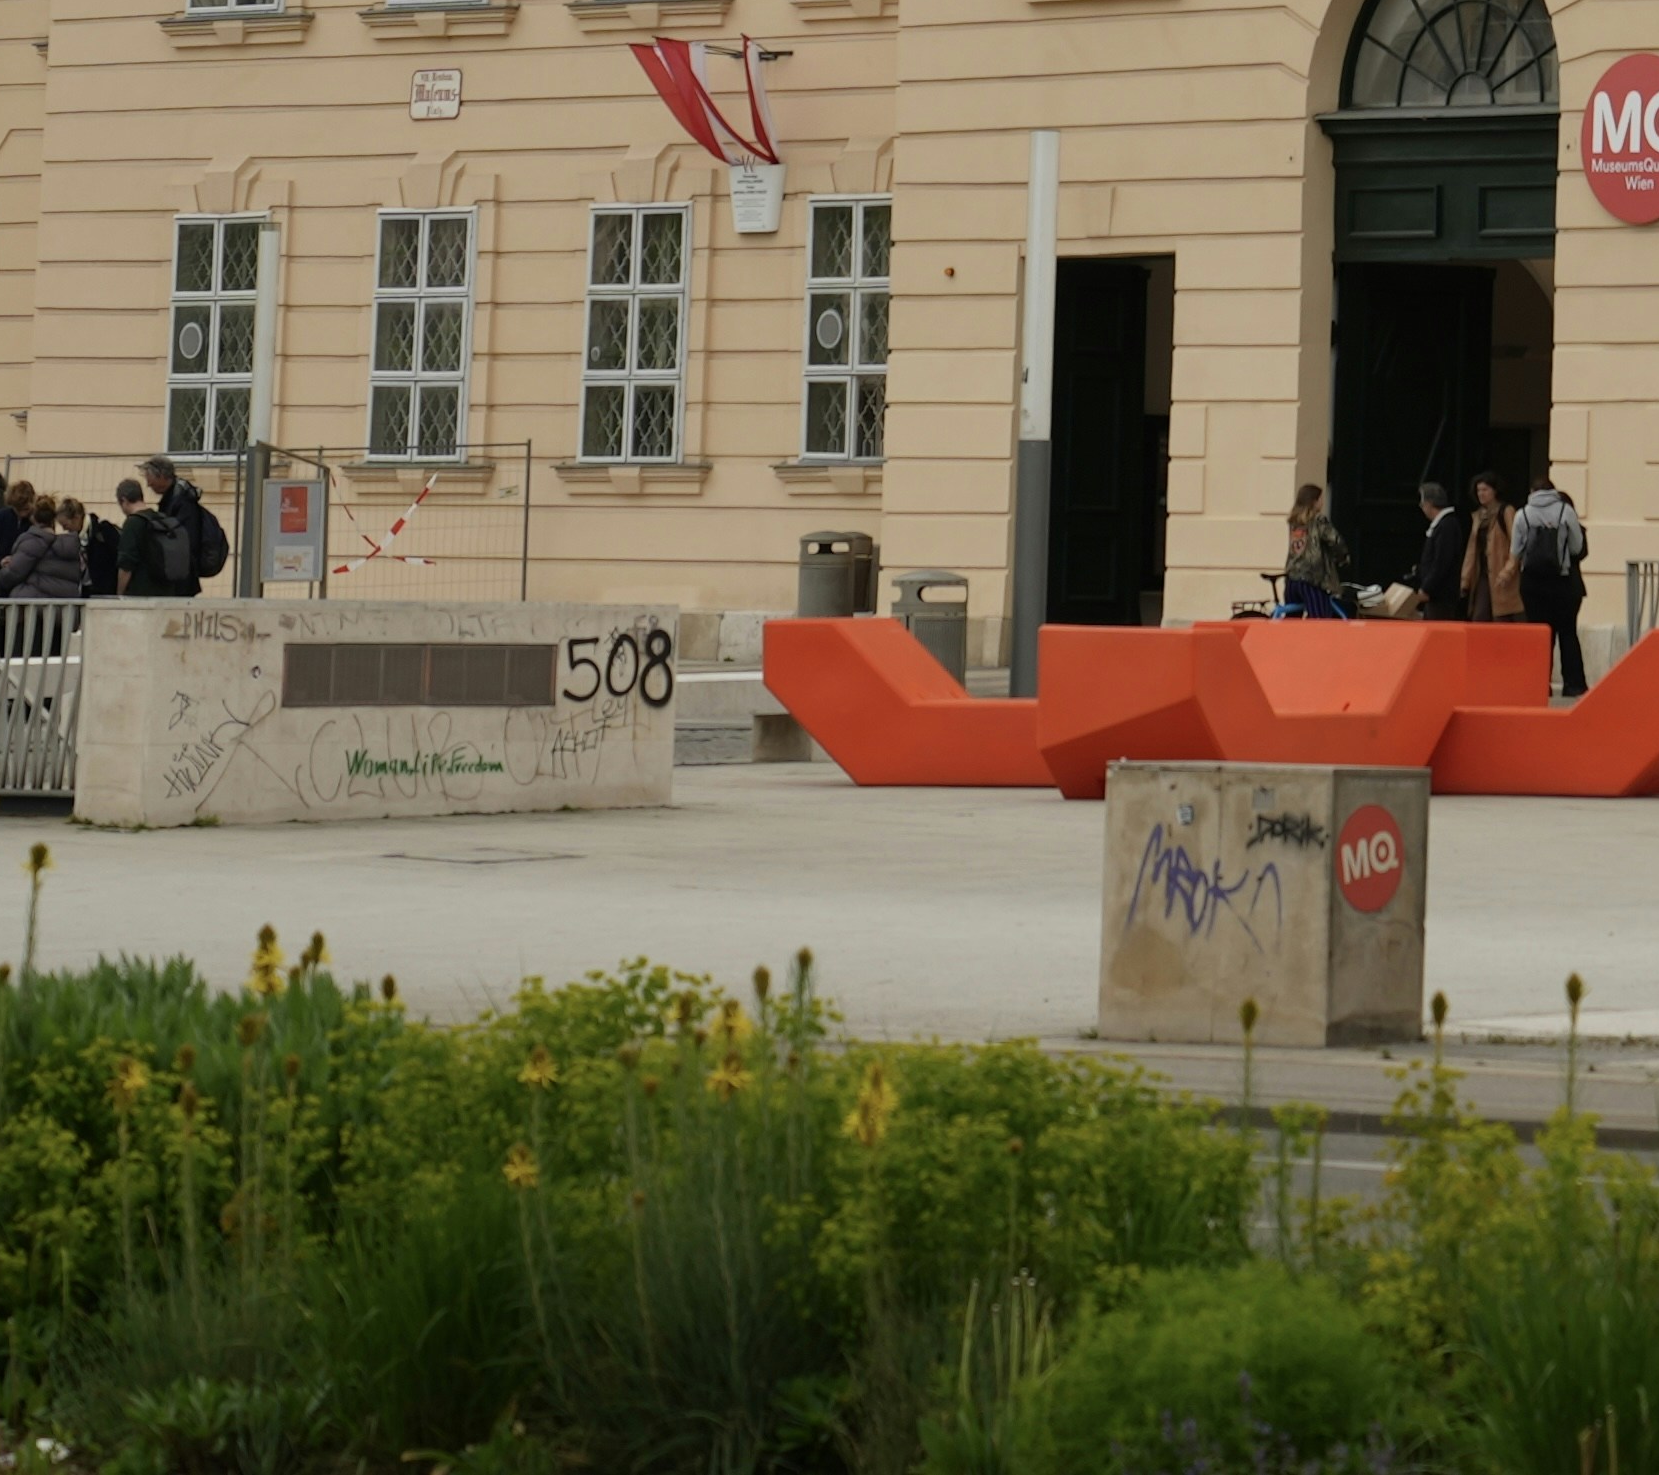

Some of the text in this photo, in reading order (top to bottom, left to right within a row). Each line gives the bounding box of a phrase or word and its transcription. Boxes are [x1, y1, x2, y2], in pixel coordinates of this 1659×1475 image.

[1624, 174, 1655, 191] Wien
[563, 628, 673, 707] 508
[1341, 830, 1400, 885] MQ
